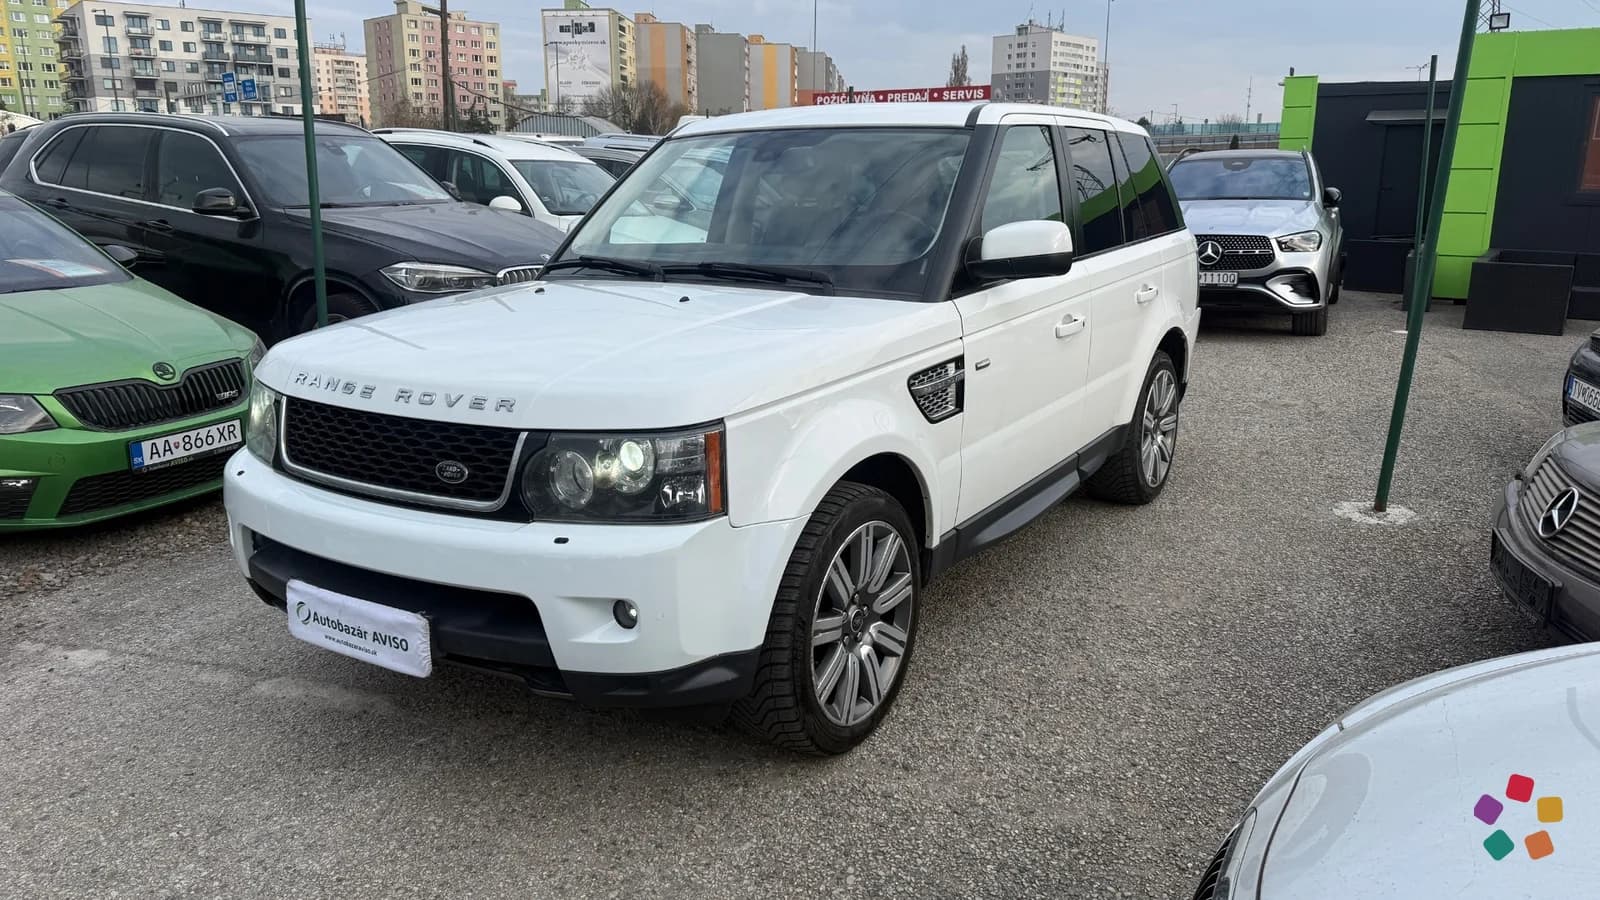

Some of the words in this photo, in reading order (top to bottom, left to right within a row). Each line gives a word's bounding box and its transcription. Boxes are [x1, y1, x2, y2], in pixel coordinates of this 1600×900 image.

[816, 92, 876, 105] POŽIČVŇA
[887, 92, 928, 103] PREDAJ
[942, 88, 984, 100] SERVIS
[295, 372, 376, 399] RANGE
[394, 387, 516, 413] ROVER
[150, 439, 173, 460] AA
[312, 611, 368, 641] Autobazár
[372, 630, 409, 652] AVISO
